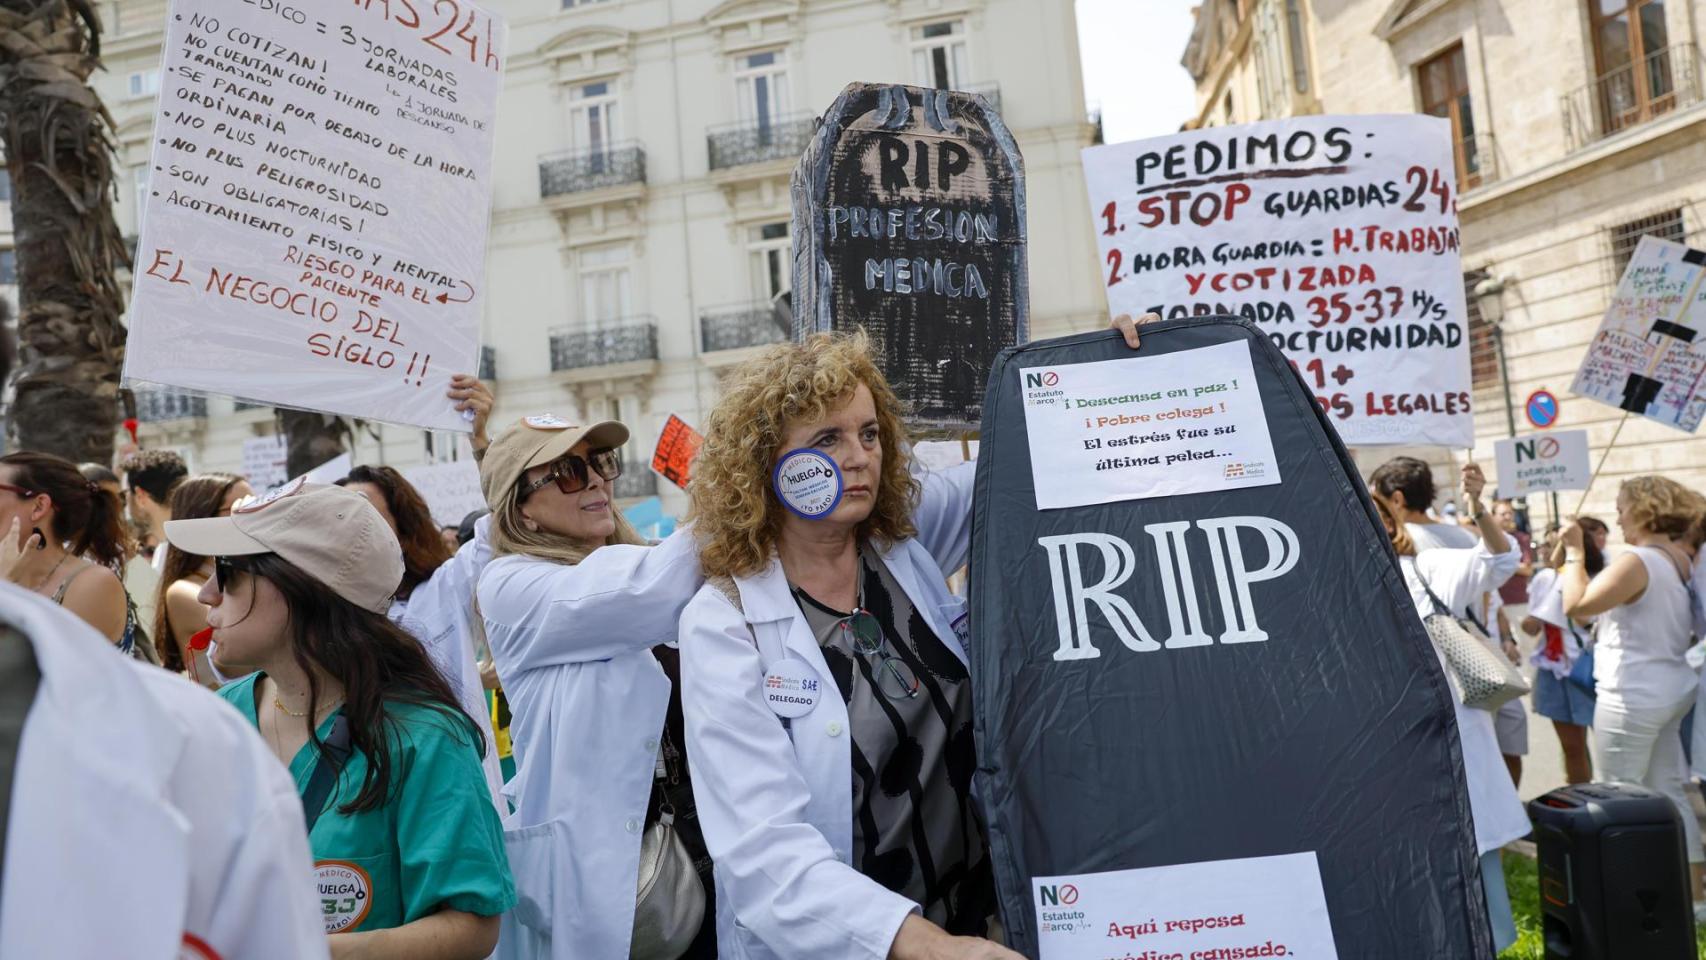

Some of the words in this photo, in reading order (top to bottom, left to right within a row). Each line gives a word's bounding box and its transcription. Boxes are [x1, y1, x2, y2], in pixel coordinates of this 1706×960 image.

[190, 13, 219, 34] NO
[421, 0, 499, 72] 24h
[243, 0, 306, 25] DICO
[340, 25, 357, 45] 3
[362, 37, 458, 86] JORNADAS
[182, 48, 272, 87] TRABAJADO
[184, 33, 207, 49] NO
[214, 45, 284, 78] CUENTAN
[288, 73, 327, 95] COMO
[334, 89, 380, 116] TIEMPO
[365, 58, 458, 103] LABORALES
[175, 112, 205, 128] NO
[214, 123, 256, 146] PLUS
[179, 66, 206, 83] SE
[213, 78, 274, 106] PAGAN
[282, 103, 317, 125] POR
[325, 119, 382, 148] DEBAJO
[388, 143, 408, 159] DE
[414, 153, 433, 167] LA
[440, 162, 477, 180] HORA
[169, 165, 209, 186] SON
[170, 137, 197, 153] NO
[206, 148, 244, 168] PLUS
[257, 163, 389, 217] PELIGROSIDAD
[879, 138, 969, 192] RIP
[1137, 183, 1252, 228] STOP
[1264, 180, 1400, 219] GUARDIAS
[167, 190, 294, 238] AGOTAMIENTO
[373, 253, 382, 266] Y
[393, 260, 456, 288] MENTAL
[283, 245, 355, 279] RIESGO
[361, 270, 405, 297] PARA
[412, 287, 430, 304] EL
[1133, 246, 1206, 275] HORA
[1212, 242, 1304, 265] GUARDIA
[299, 271, 382, 308] PACIENTE
[865, 257, 988, 299] MEDICA
[146, 249, 190, 285] EL
[205, 267, 338, 322] NEGOCIO
[352, 310, 405, 346] DEL
[1306, 286, 1404, 328] 35-37
[1269, 322, 1462, 353] OCTURNIDAD
[1028, 390, 1064, 399] Estatuto
[1076, 390, 1162, 409] Descansa
[1167, 388, 1188, 398] en
[1193, 382, 1228, 397] paz
[1366, 391, 1471, 417] LEGALES
[1097, 412, 1150, 428] Pobre
[1155, 404, 1215, 420] colega
[1083, 439, 1101, 451] El
[1107, 430, 1171, 448] estrés
[1176, 426, 1209, 440] fue
[1214, 424, 1236, 436] su
[788, 466, 823, 485] HUELGA
[1095, 455, 1160, 472] última
[1037, 515, 1300, 661] RIP
[769, 694, 812, 705] DELEGADO
[1043, 911, 1085, 921] Estatuto
[1164, 913, 1246, 933] reposa
